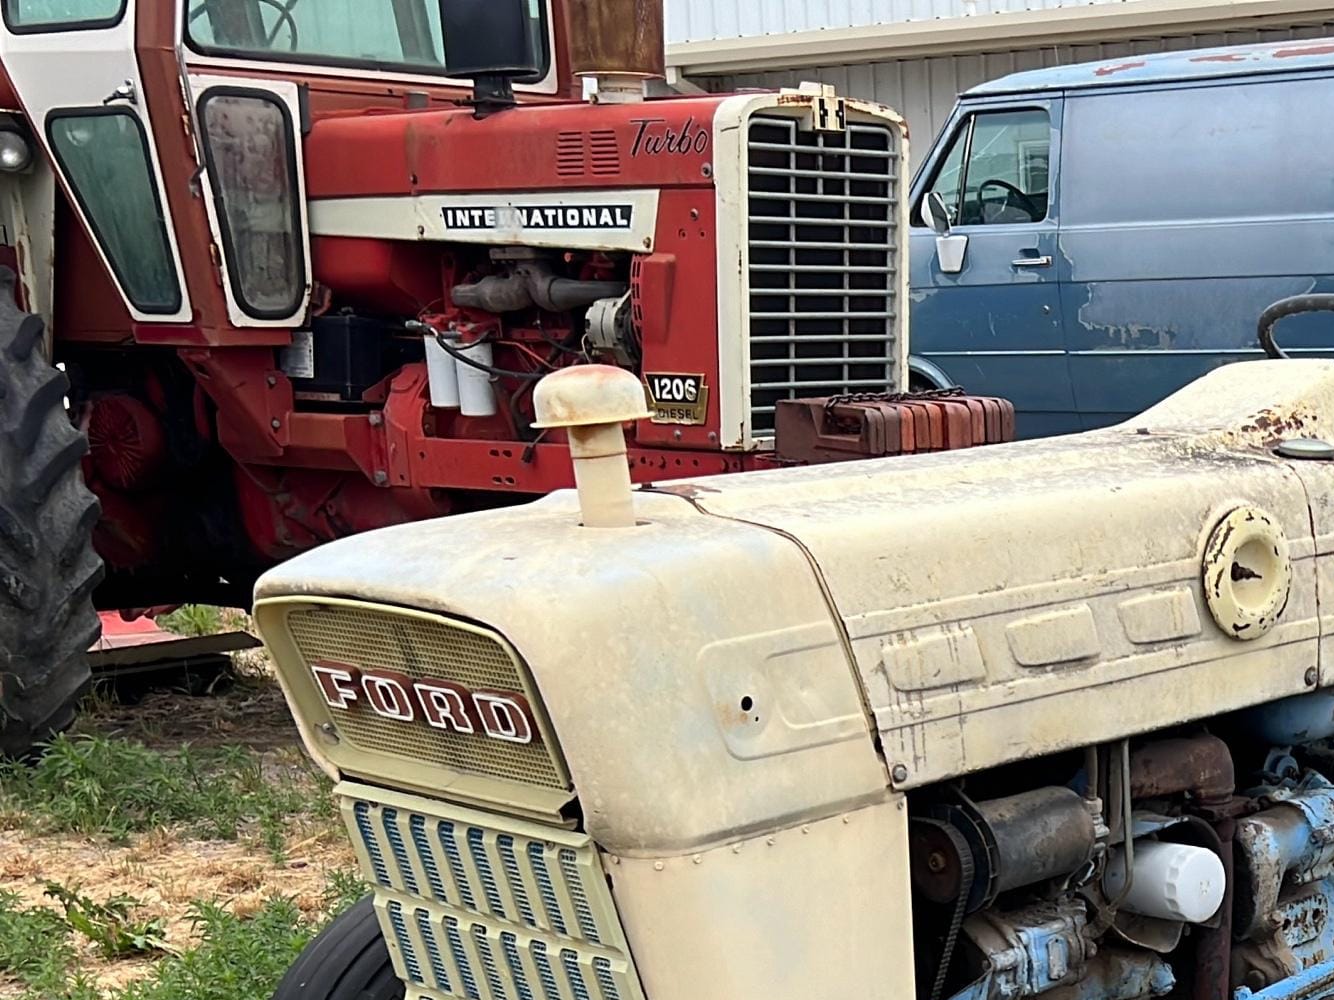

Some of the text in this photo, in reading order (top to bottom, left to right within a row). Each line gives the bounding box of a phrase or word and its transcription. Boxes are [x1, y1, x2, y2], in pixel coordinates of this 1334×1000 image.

[629, 116, 708, 157] Turbo
[447, 208, 628, 227] INTENATIONAL
[654, 378, 697, 401] 1206
[657, 408, 699, 420] DIESEL
[311, 661, 536, 745] FORD
